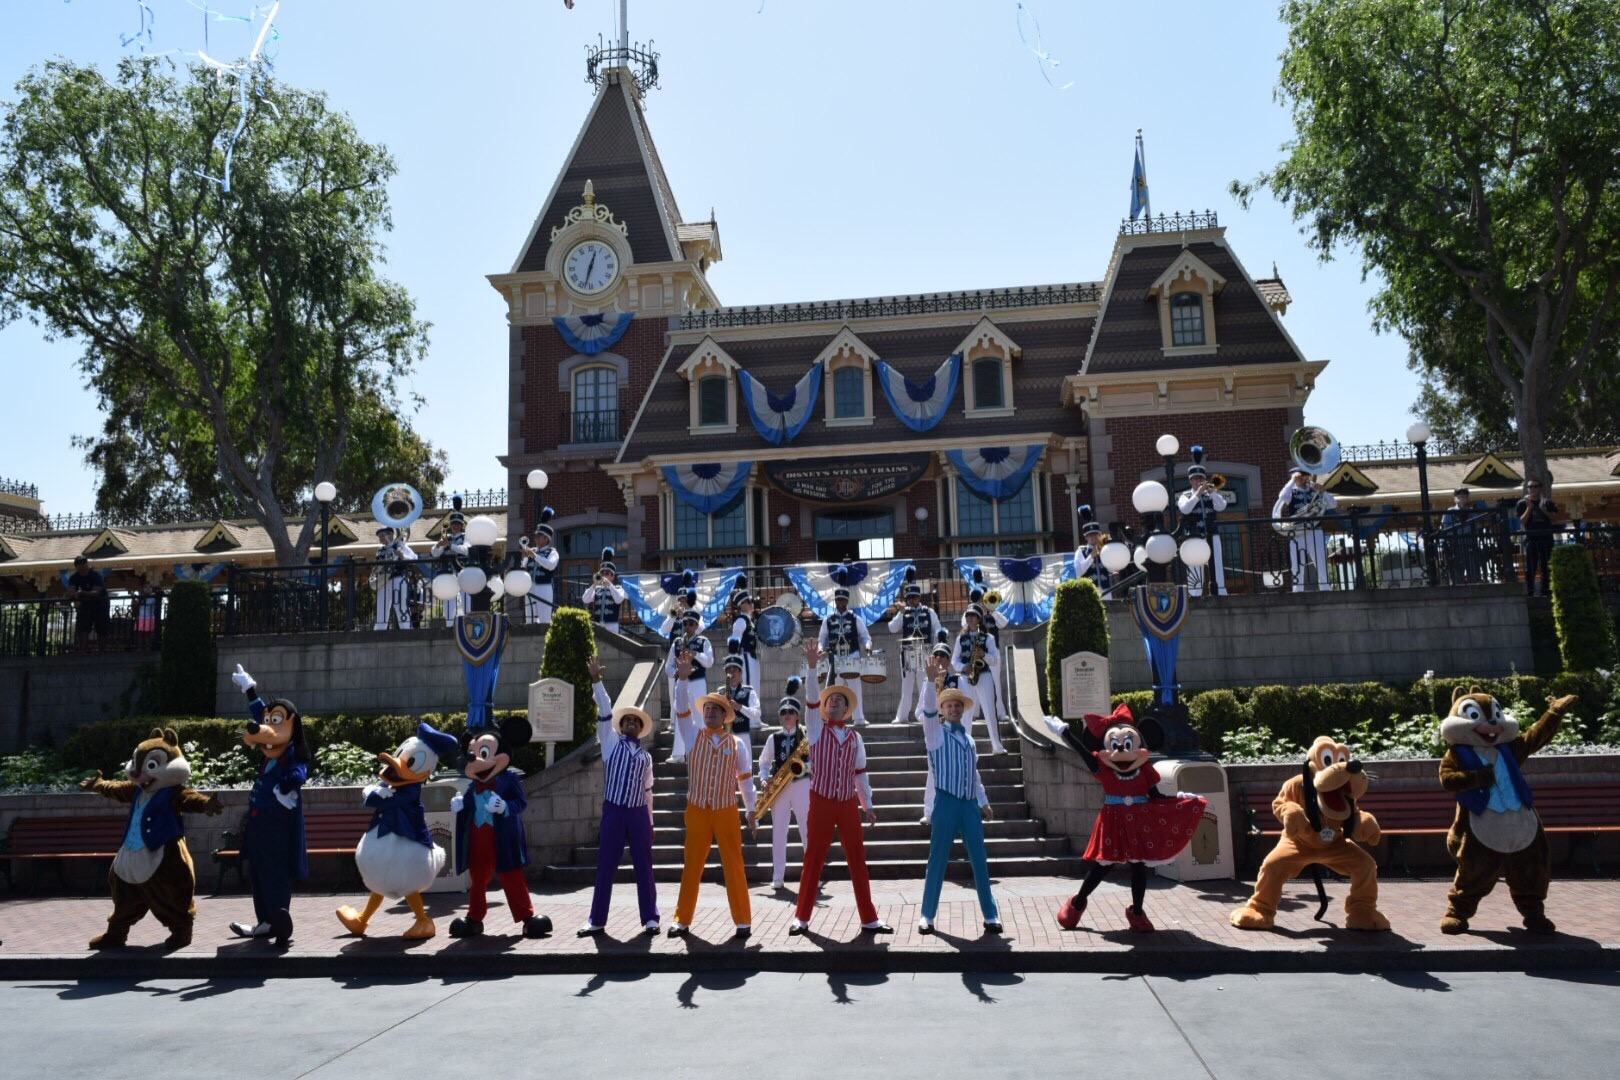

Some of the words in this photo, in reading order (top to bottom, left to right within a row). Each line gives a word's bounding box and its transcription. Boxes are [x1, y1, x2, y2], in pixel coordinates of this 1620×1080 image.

[785, 471, 830, 479] DISNEY'S
[832, 468, 867, 476] STEAM
[870, 466, 908, 474] TRAINS
